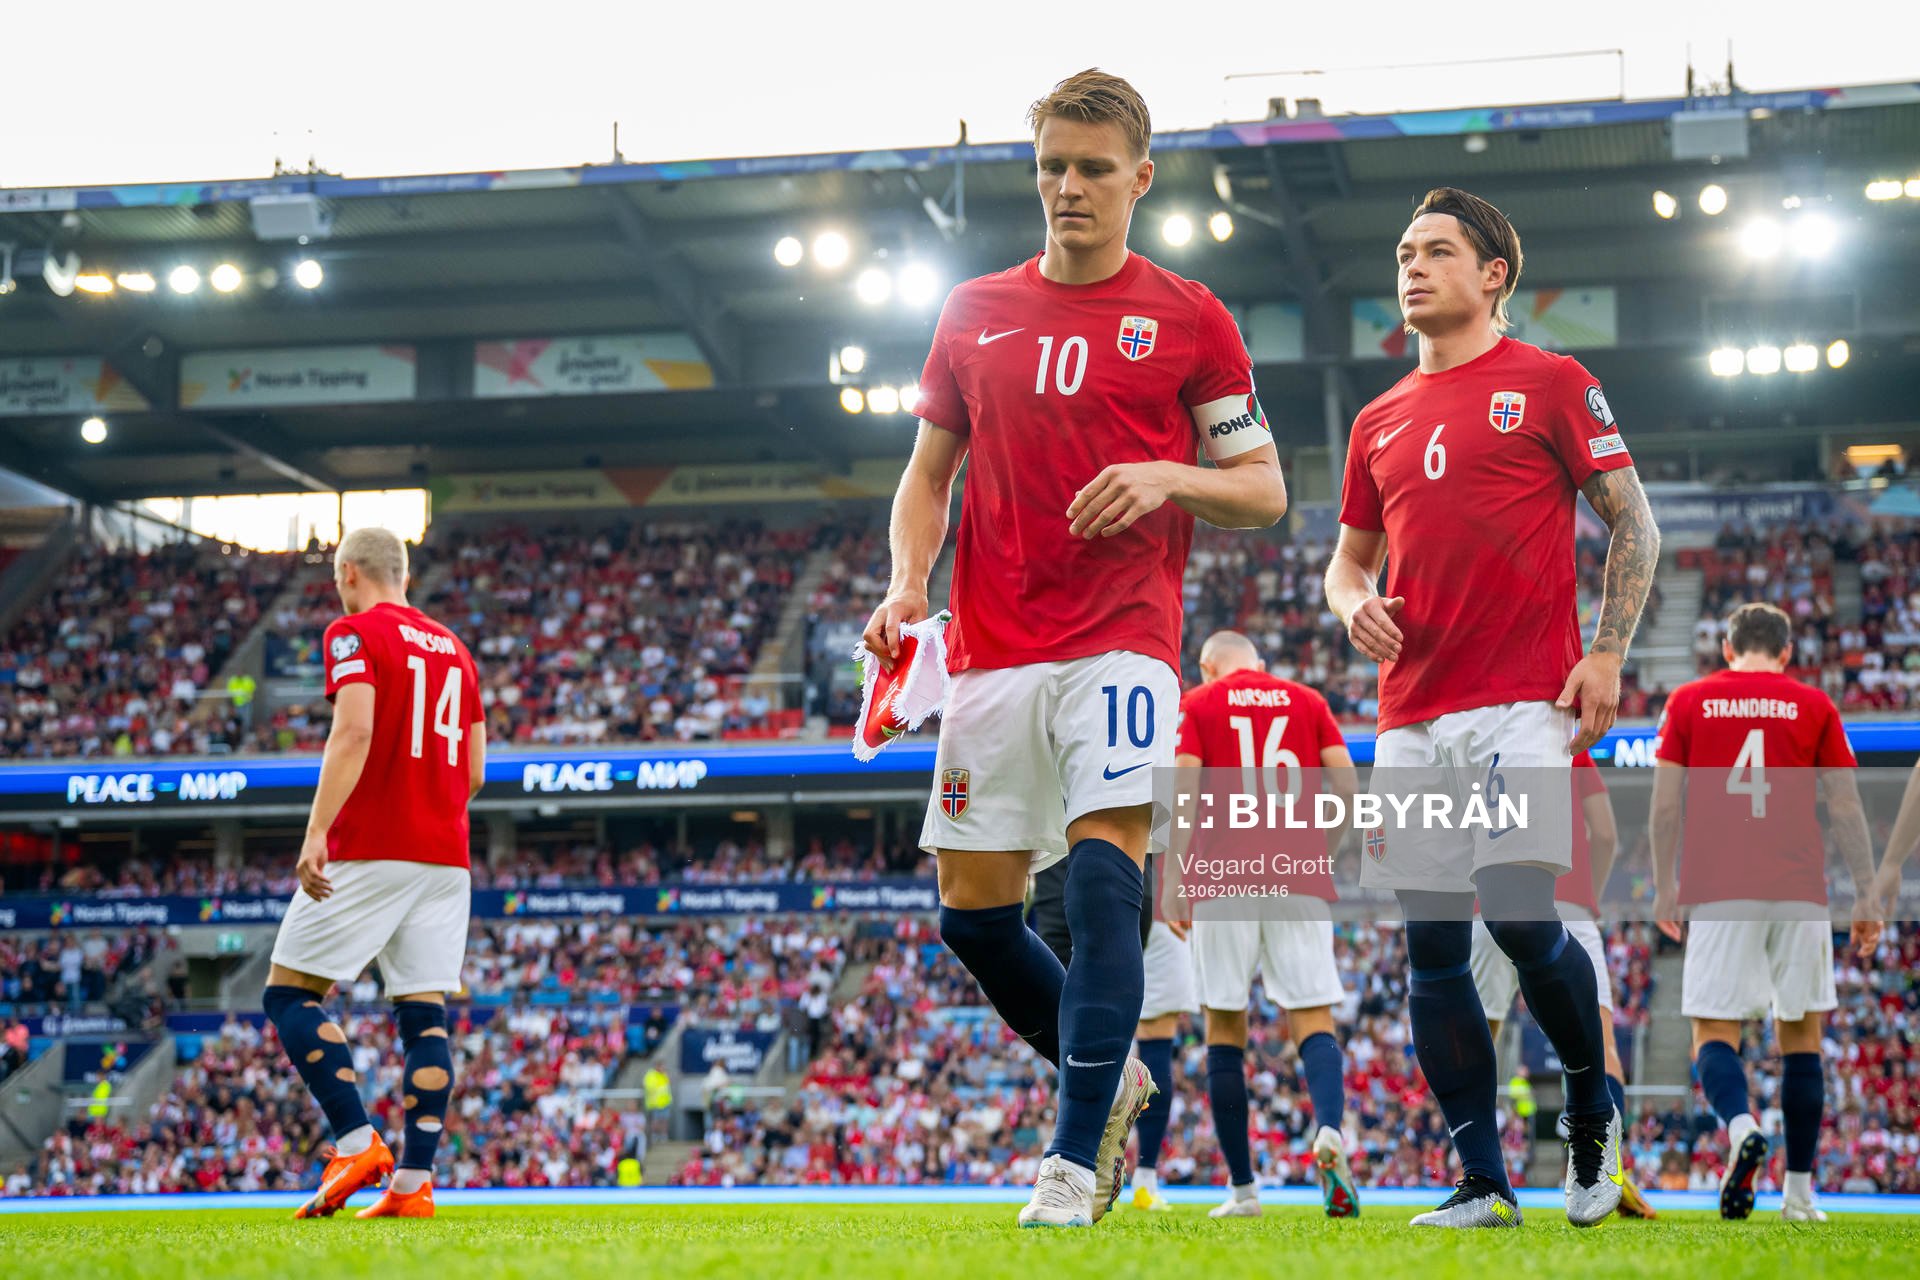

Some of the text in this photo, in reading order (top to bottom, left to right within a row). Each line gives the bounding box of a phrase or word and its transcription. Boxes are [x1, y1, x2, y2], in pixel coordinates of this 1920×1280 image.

[1035, 335, 1089, 396] 10
[1209, 413, 1253, 439] #ONE
[1423, 423, 1447, 480] 6
[407, 654, 464, 767] 14
[1101, 685, 1155, 749] 10
[1227, 688, 1292, 708] AURSNES
[1702, 698, 1798, 720] STRANDBERG
[67, 774, 155, 803] PEACE
[522, 761, 614, 792] PEACE
[1229, 714, 1303, 808] 16
[1485, 752, 1506, 809] 6
[1725, 728, 1772, 818] 4
